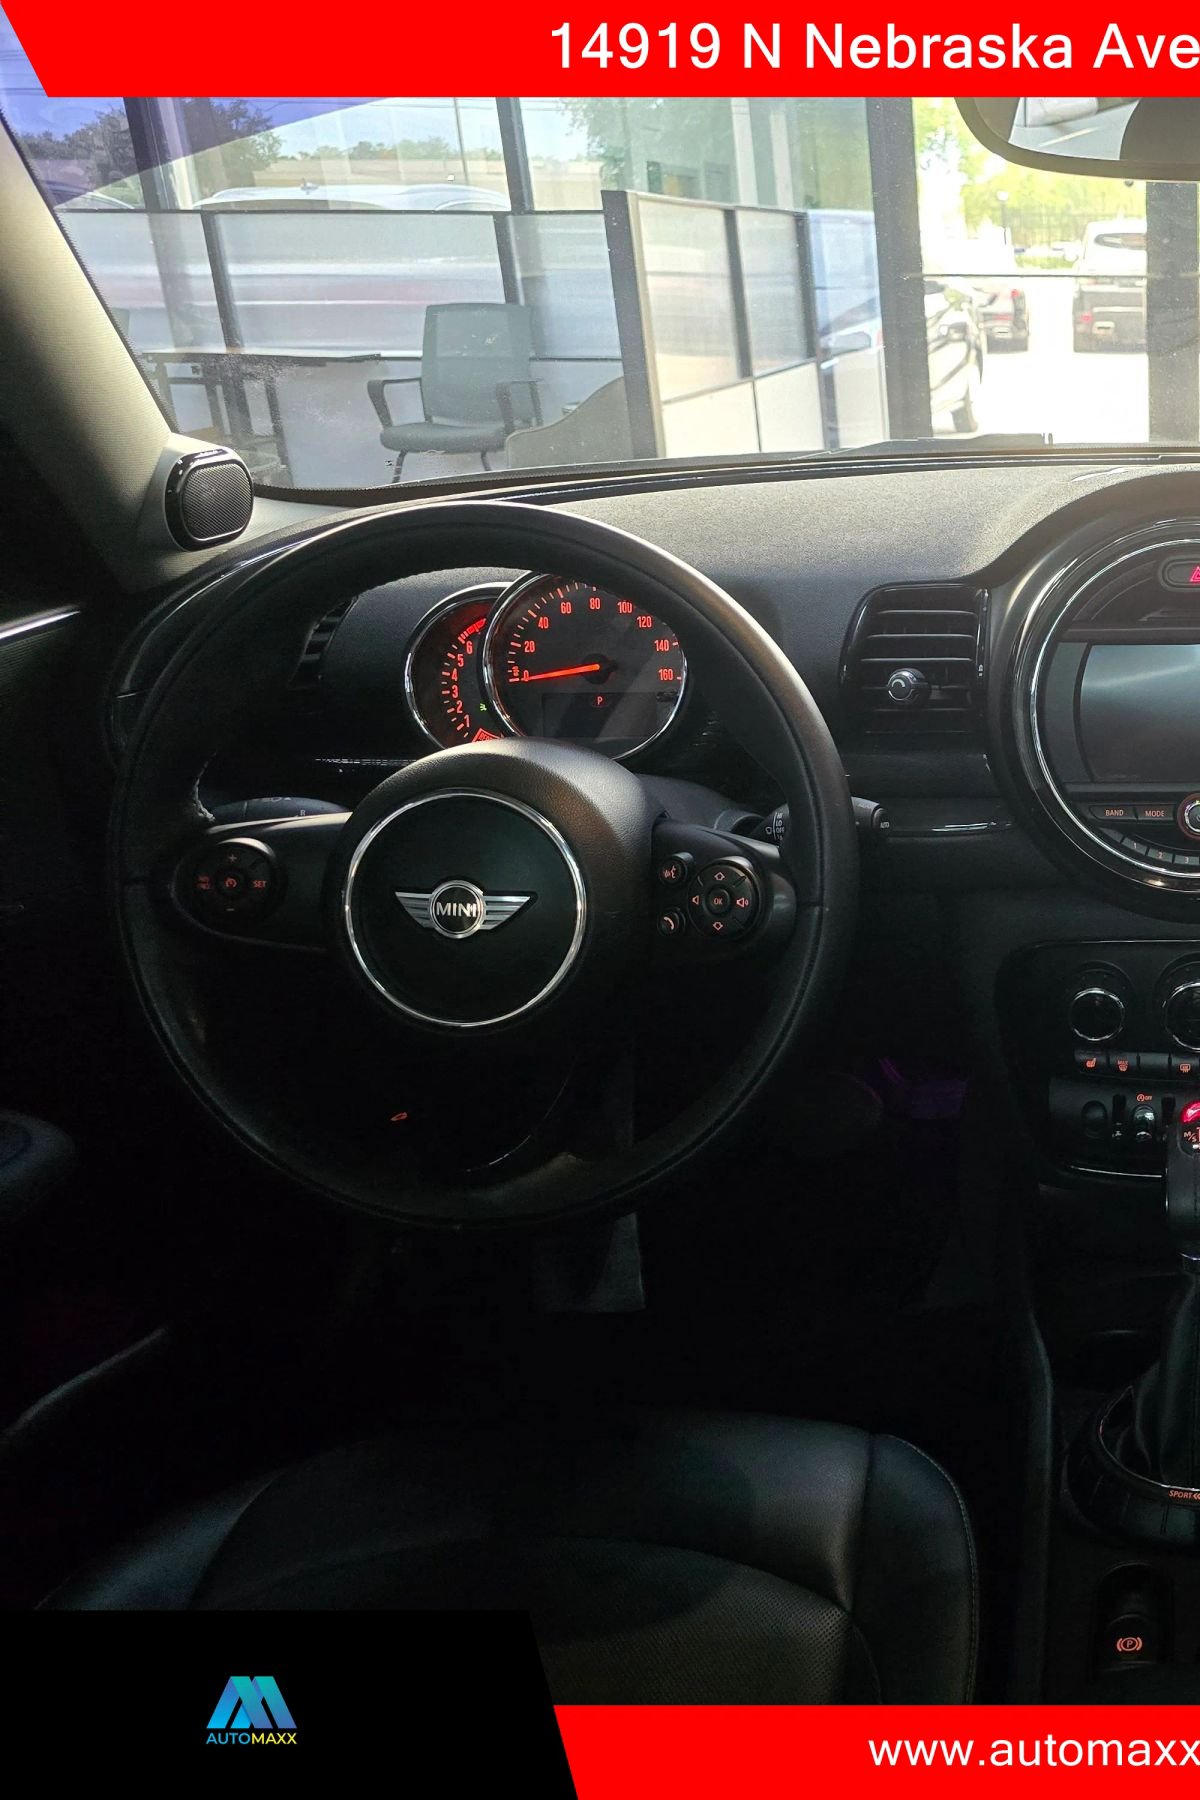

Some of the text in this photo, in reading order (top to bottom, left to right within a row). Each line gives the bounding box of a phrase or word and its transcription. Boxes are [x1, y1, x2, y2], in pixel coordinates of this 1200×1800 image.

[560, 602, 571, 614] 60
[589, 598, 600, 610] 80
[538, 617, 549, 629] 40
[524, 641, 535, 653] 20
[1105, 809, 1124, 817] BAND
[1145, 810, 1165, 818] MODE
[436, 901, 477, 918] MINI
[1168, 1490, 1192, 1499] SPORT
